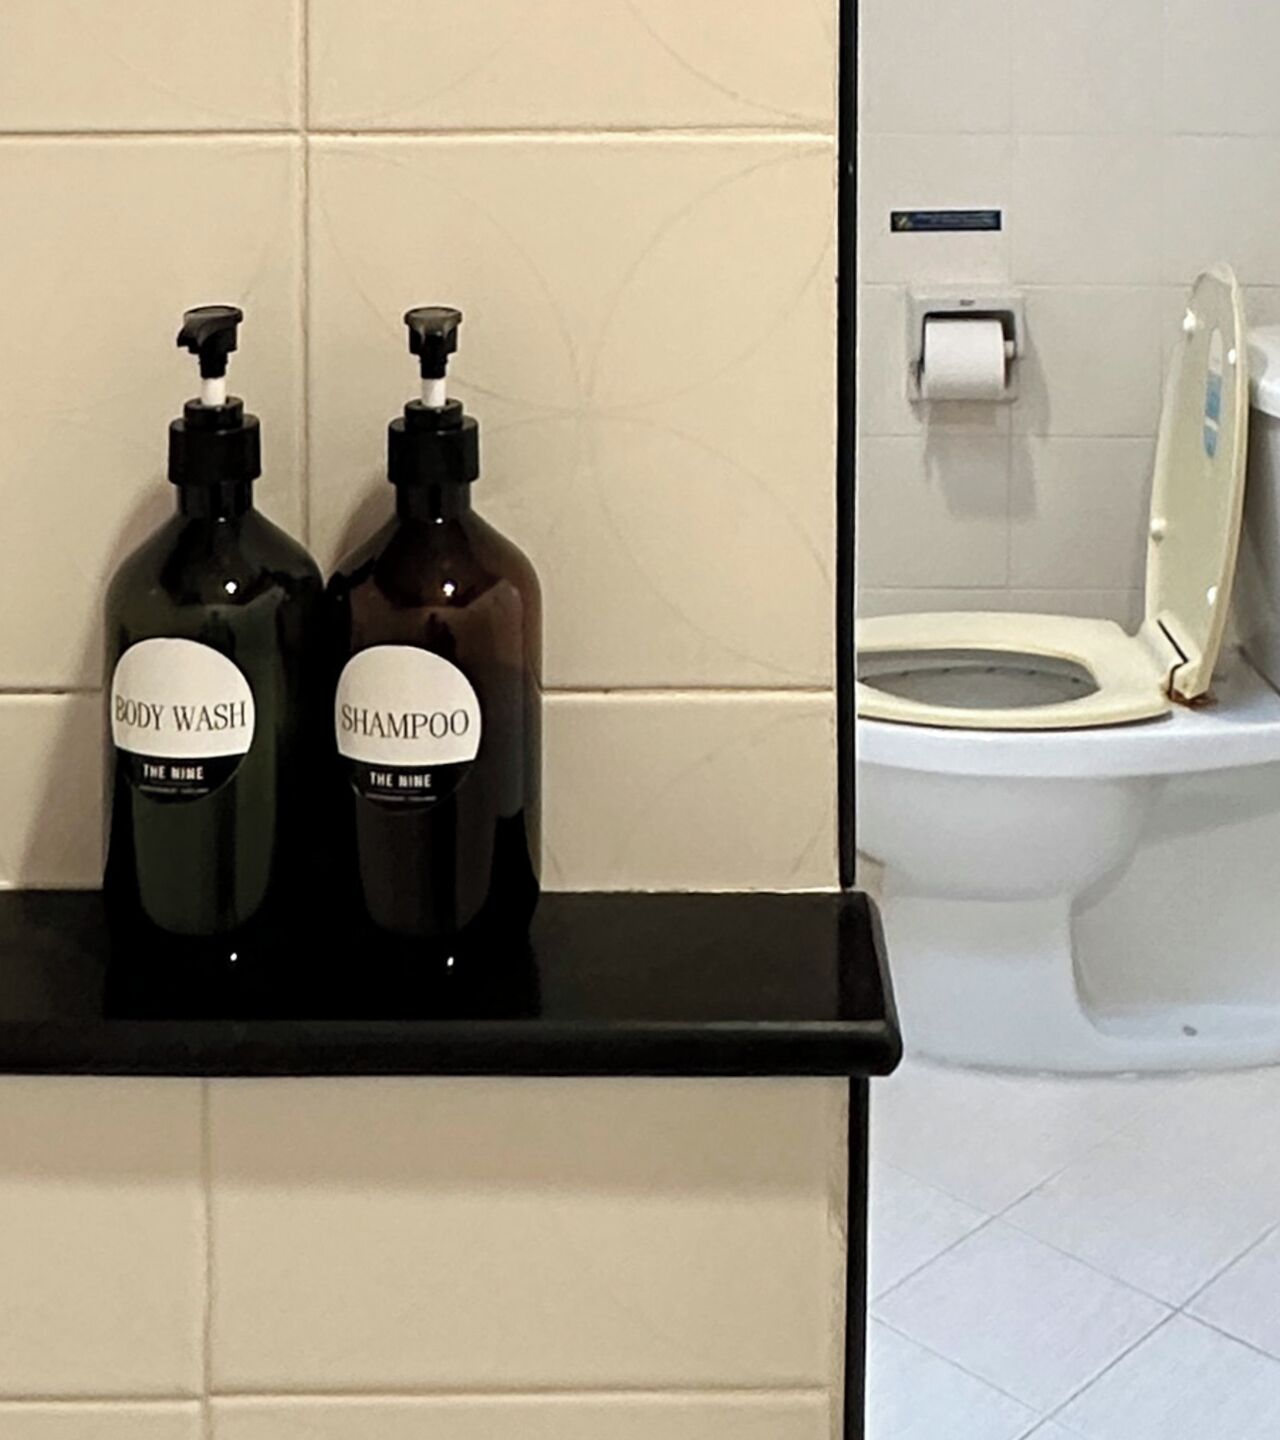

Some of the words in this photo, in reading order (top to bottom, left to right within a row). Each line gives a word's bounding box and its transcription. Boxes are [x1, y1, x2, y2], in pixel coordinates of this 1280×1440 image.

[115, 694, 165, 731] BODY
[172, 700, 246, 732] WASH
[341, 704, 470, 740] SHAMPOO
[142, 763, 166, 779] THE
[369, 771, 393, 788] THE
